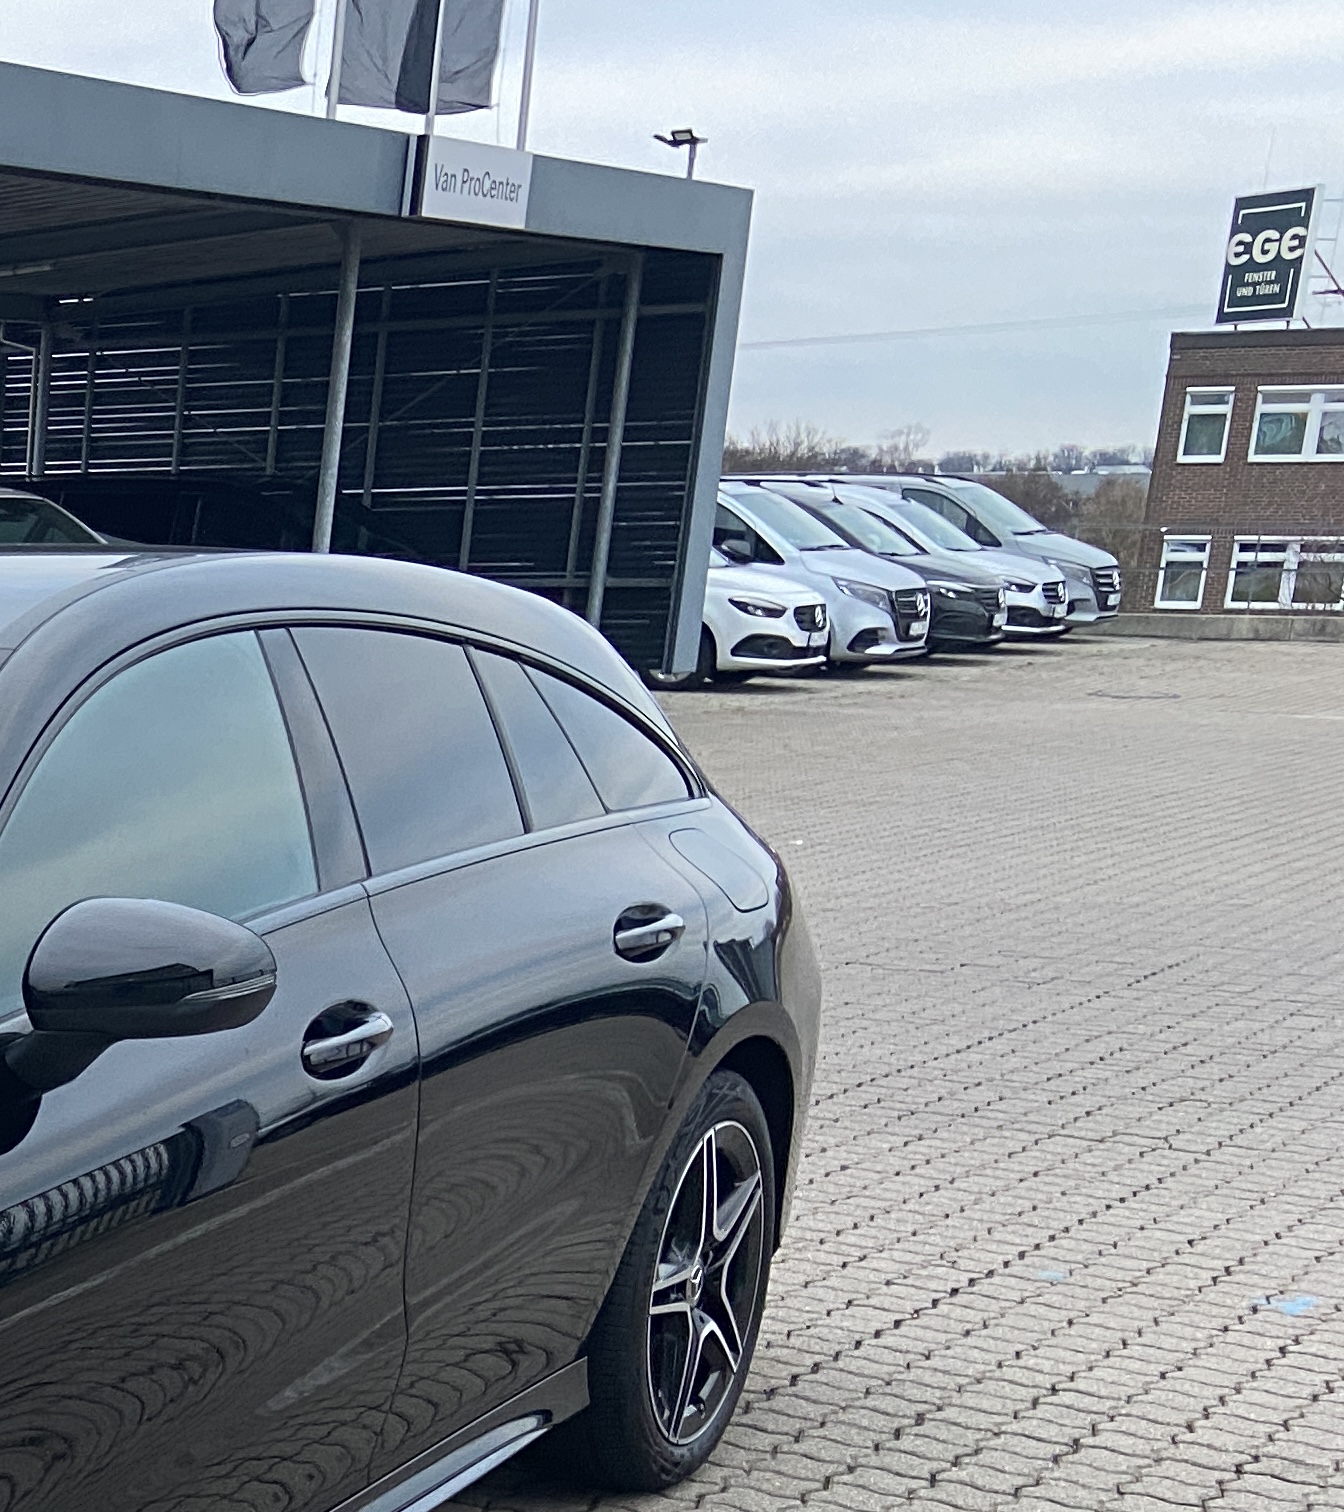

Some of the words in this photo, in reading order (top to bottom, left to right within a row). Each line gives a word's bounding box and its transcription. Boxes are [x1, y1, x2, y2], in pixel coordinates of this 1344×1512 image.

[434, 162, 458, 194] Van
[460, 167, 523, 204] ProCenter
[1226, 226, 1308, 266] EGE
[1236, 286, 1254, 297] UND
[1255, 283, 1281, 296] TÜREN
[1244, 270, 1277, 283] FENSTER
